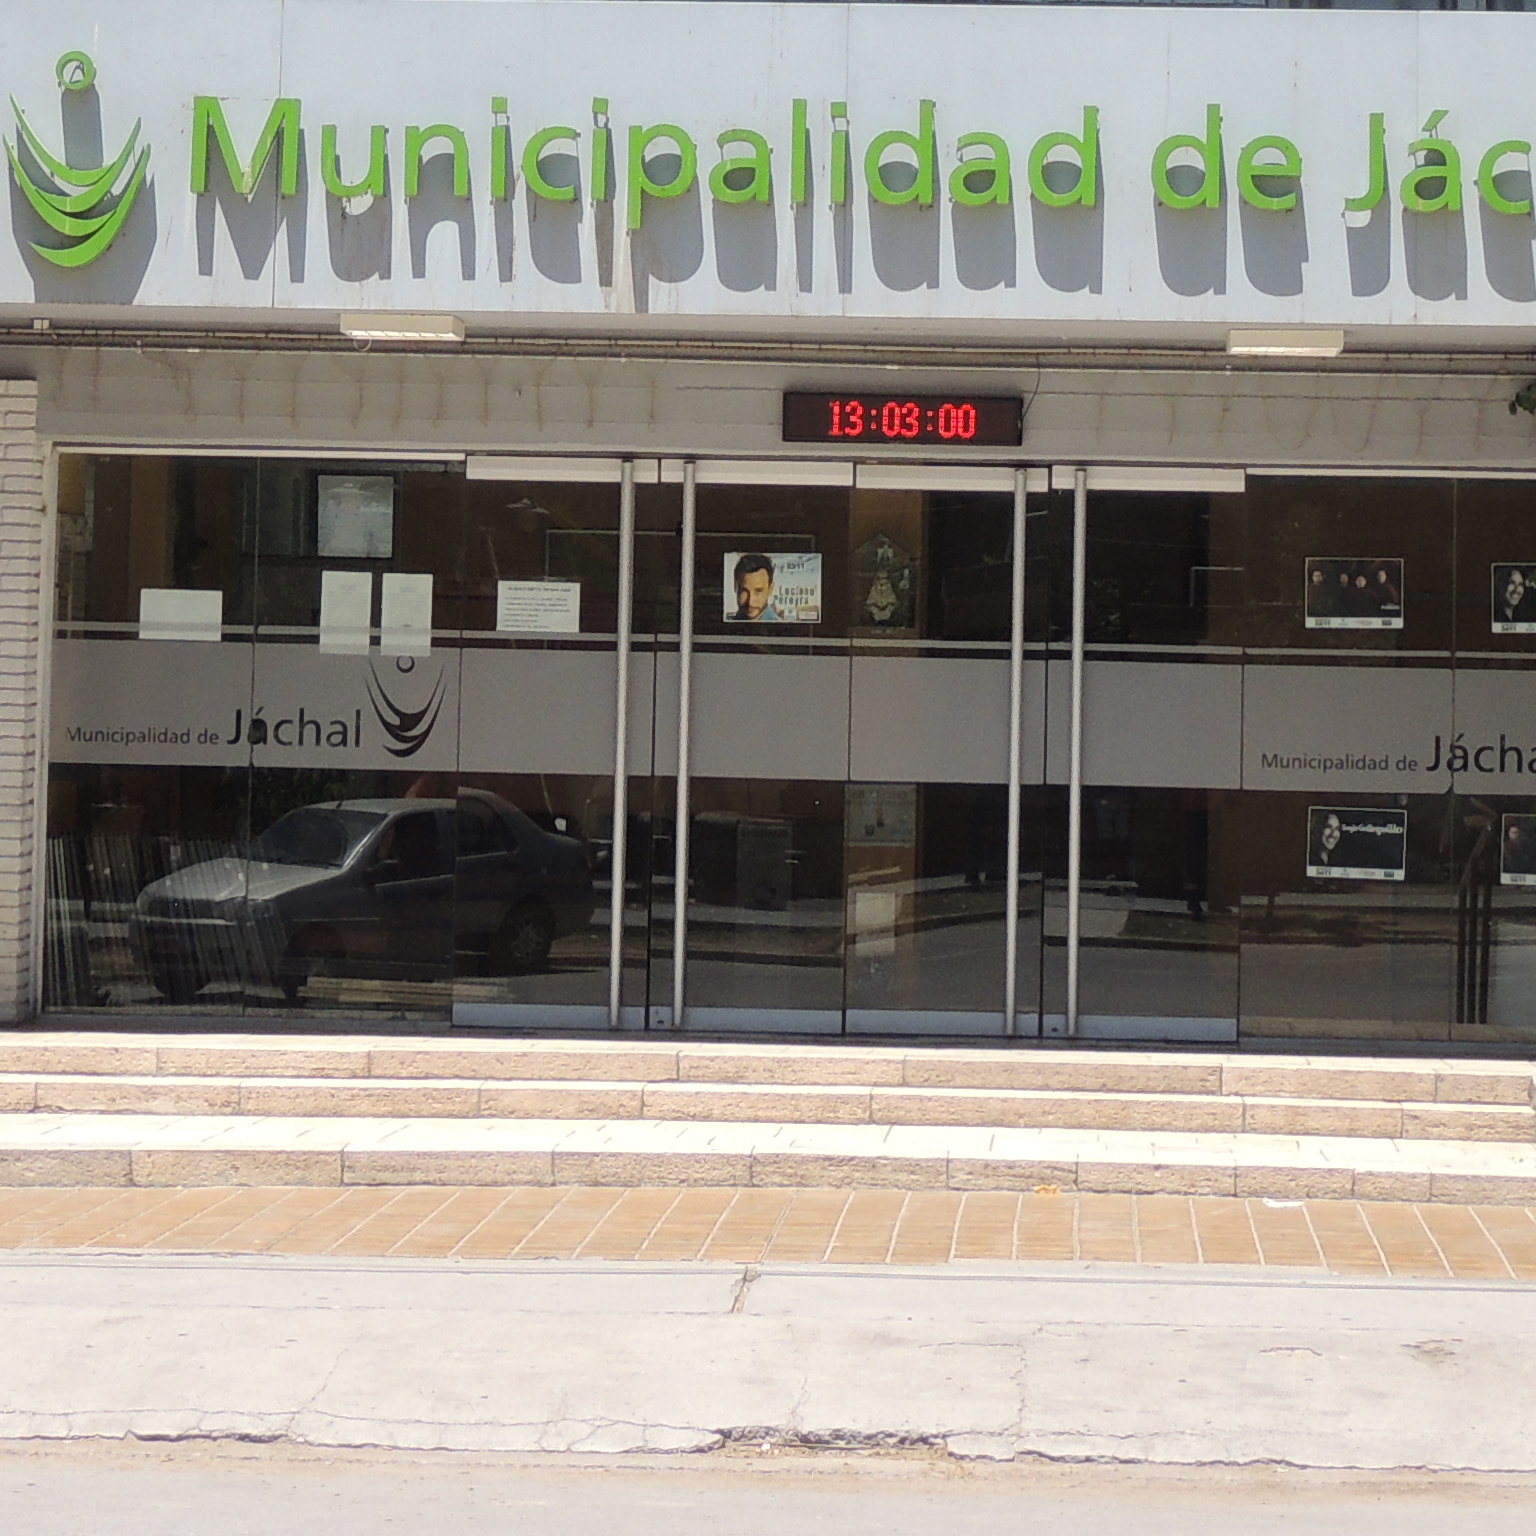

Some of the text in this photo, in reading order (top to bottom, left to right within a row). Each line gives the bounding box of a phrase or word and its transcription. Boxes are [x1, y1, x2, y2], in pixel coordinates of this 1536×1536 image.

[191, 96, 1098, 230] Municipalidad
[1152, 104, 1302, 212] de
[828, 400, 978, 439] 13:03:00
[66, 705, 362, 749] Municipalidad de Jáchal
[1260, 752, 1389, 774] Municipalidad
[1395, 754, 1419, 772] de
